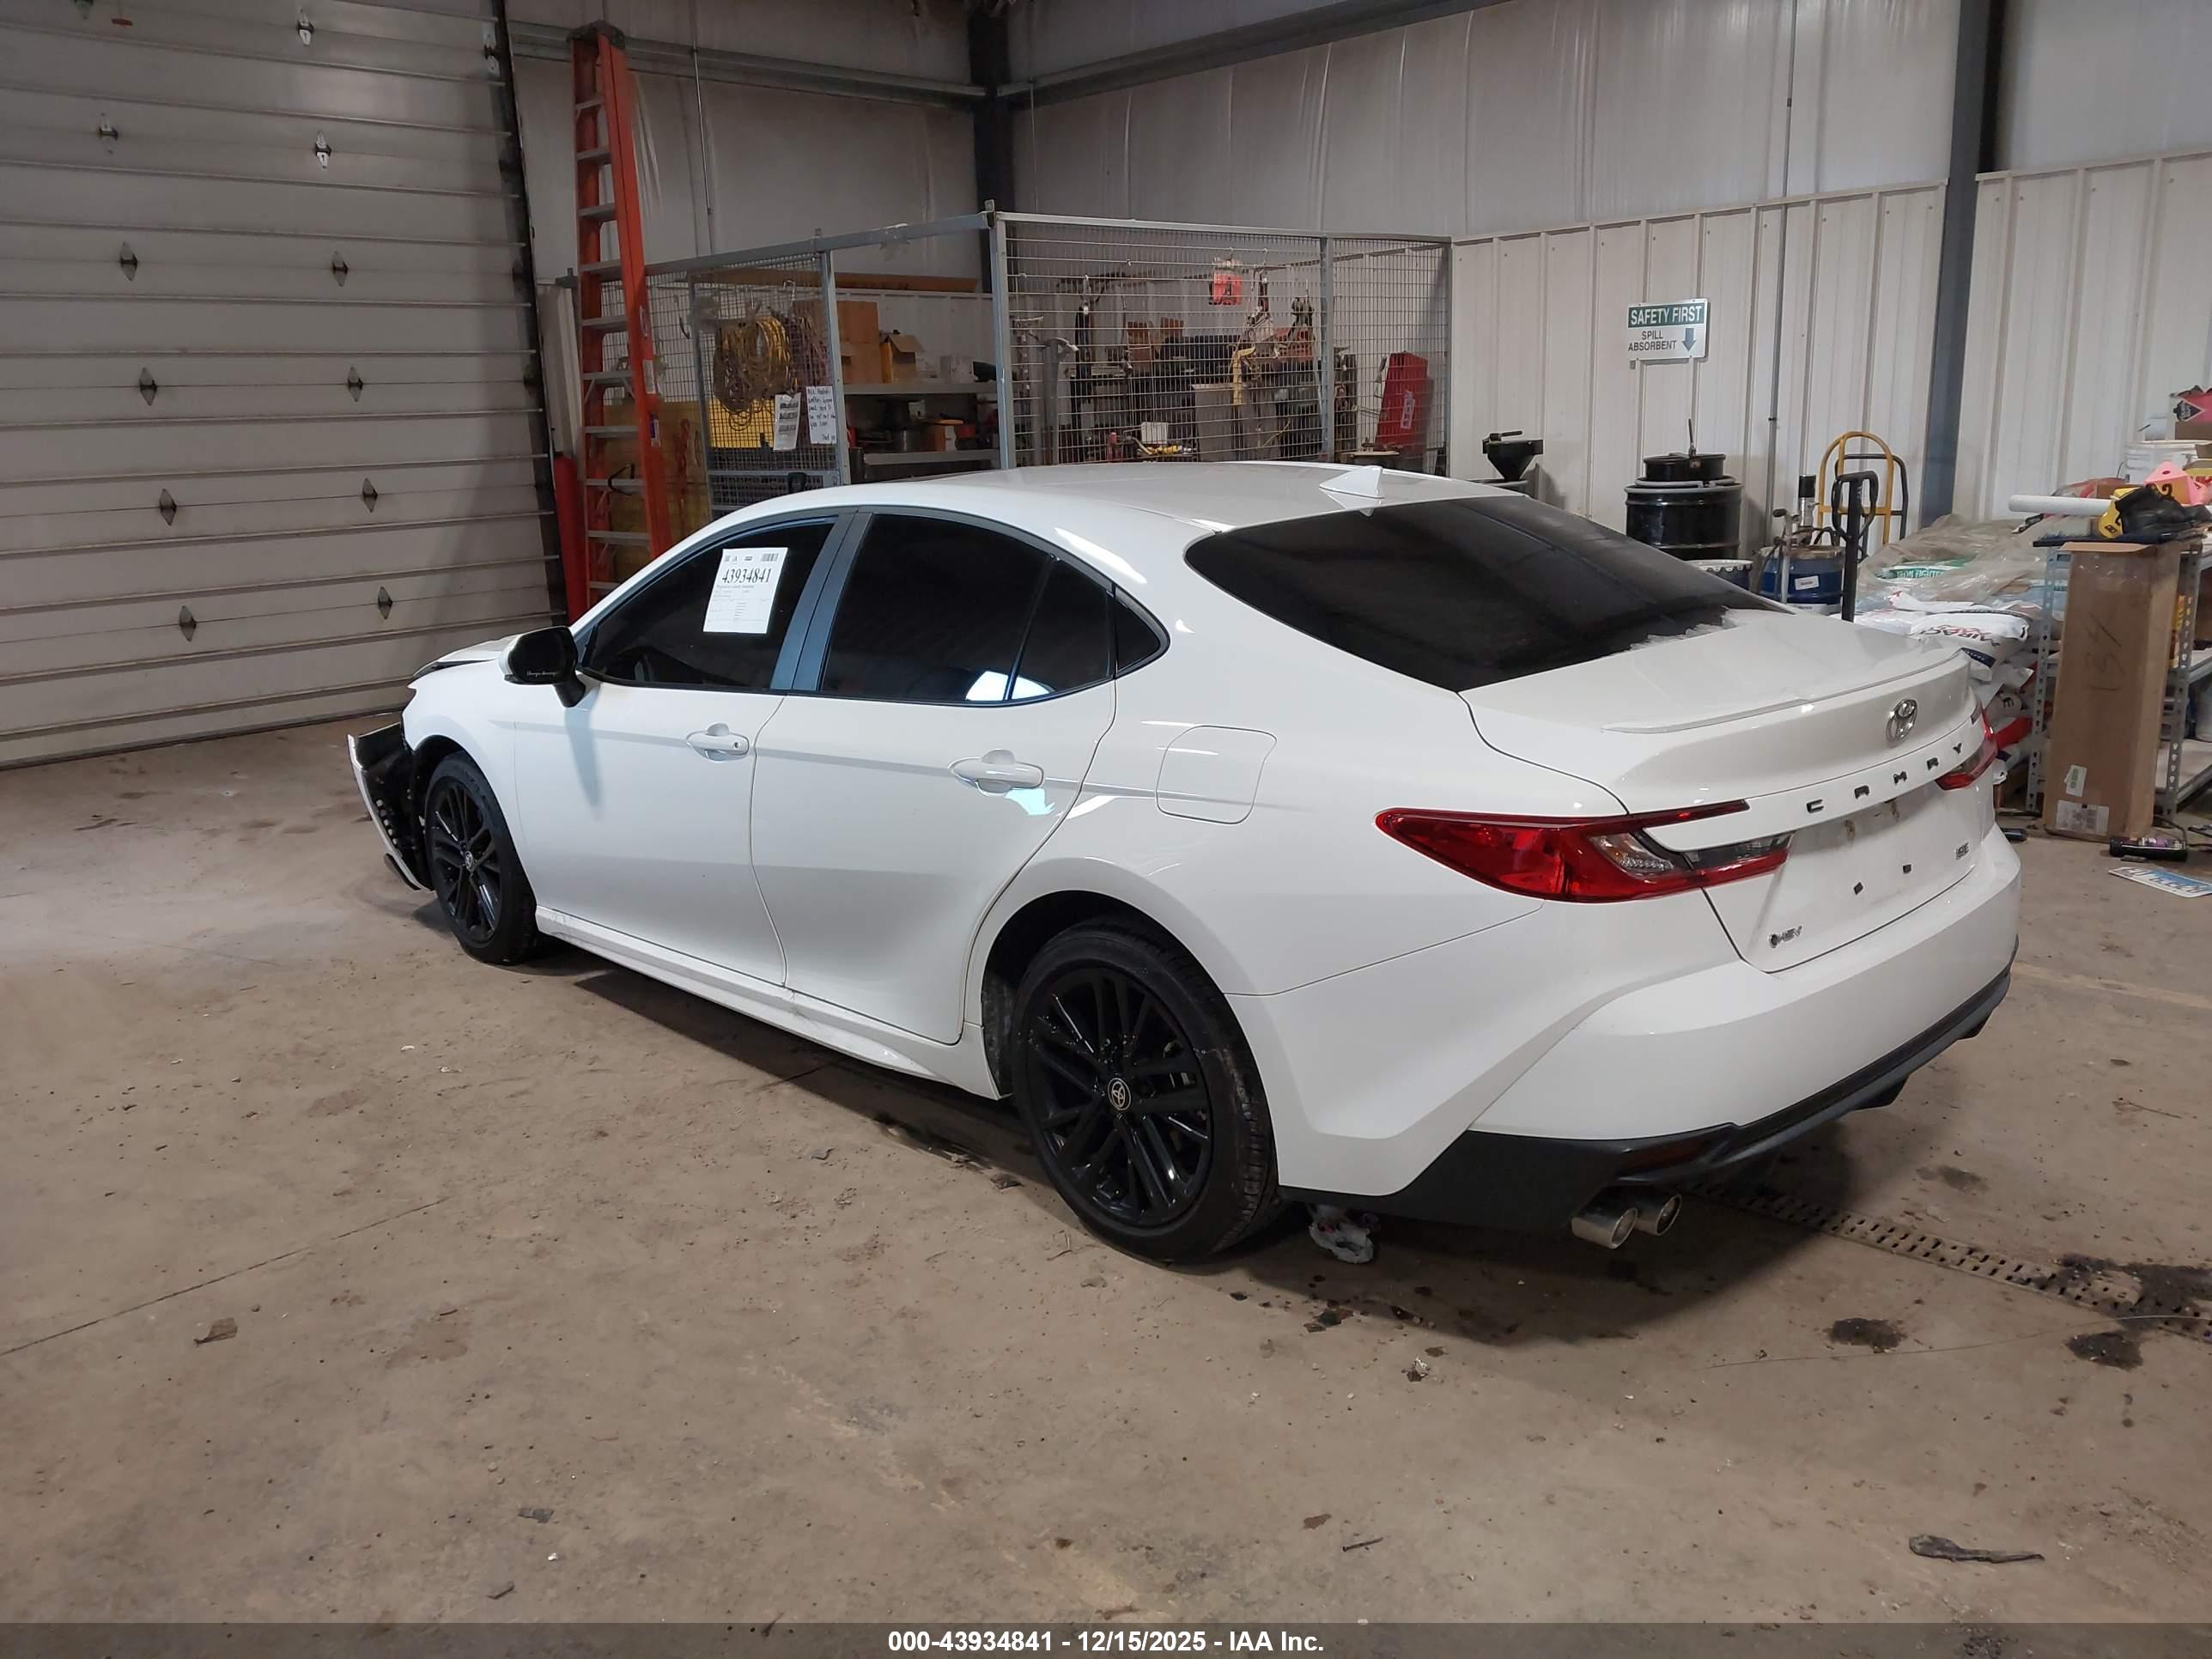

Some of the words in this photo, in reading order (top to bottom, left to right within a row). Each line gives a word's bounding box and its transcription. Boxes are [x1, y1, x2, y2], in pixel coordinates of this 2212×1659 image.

[1631, 307, 1669, 325] SAFETY
[1672, 306, 1702, 323] FIRST
[1641, 330, 1663, 340] SPILL
[1628, 340, 1677, 351] ABSORBENT
[722, 568, 772, 584] 43934841
[1806, 743, 1962, 813] CAMRY
